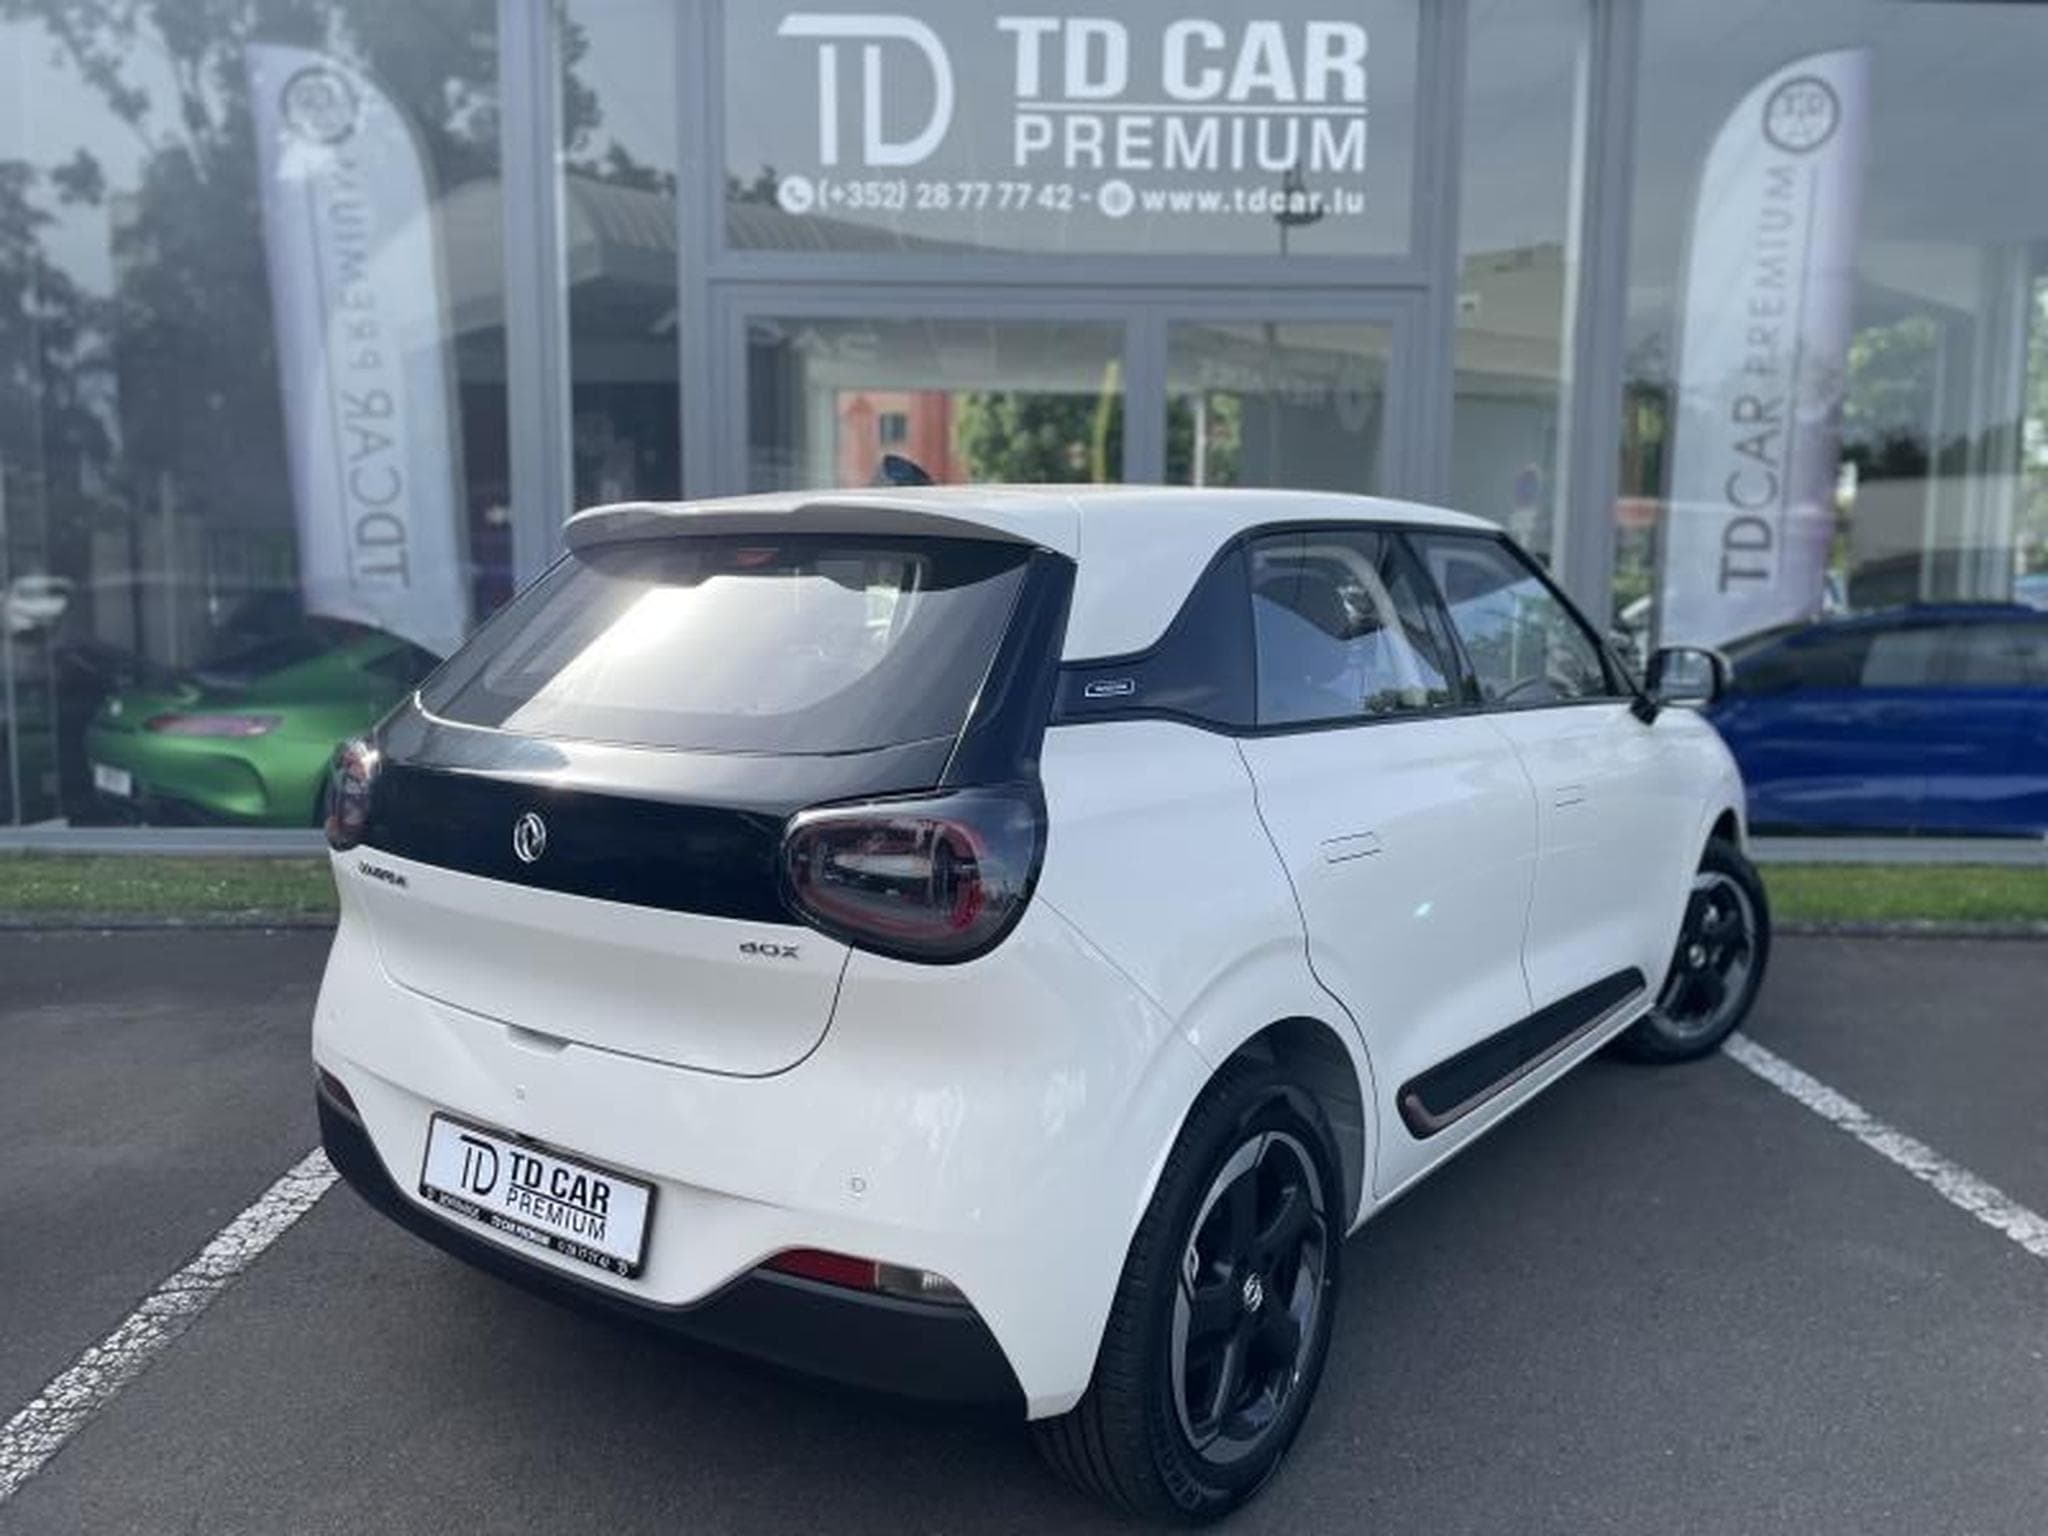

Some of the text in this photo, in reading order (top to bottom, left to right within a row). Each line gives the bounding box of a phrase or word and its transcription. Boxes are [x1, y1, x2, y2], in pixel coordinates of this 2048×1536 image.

[997, 16, 1368, 103] TD CAR
[1014, 114, 1367, 173] PREMIUM
[818, 177, 907, 211] (+352)
[916, 181, 951, 210] 28
[956, 181, 991, 210] 77
[998, 181, 1034, 210] 77
[1037, 182, 1074, 211] 42
[1140, 187, 1364, 214] www.tdcar.lu
[1718, 163, 1796, 594] TDCAR PREMIUM
[509, 1151, 611, 1214] TD CAR
[505, 1186, 607, 1242] PREMIUM
